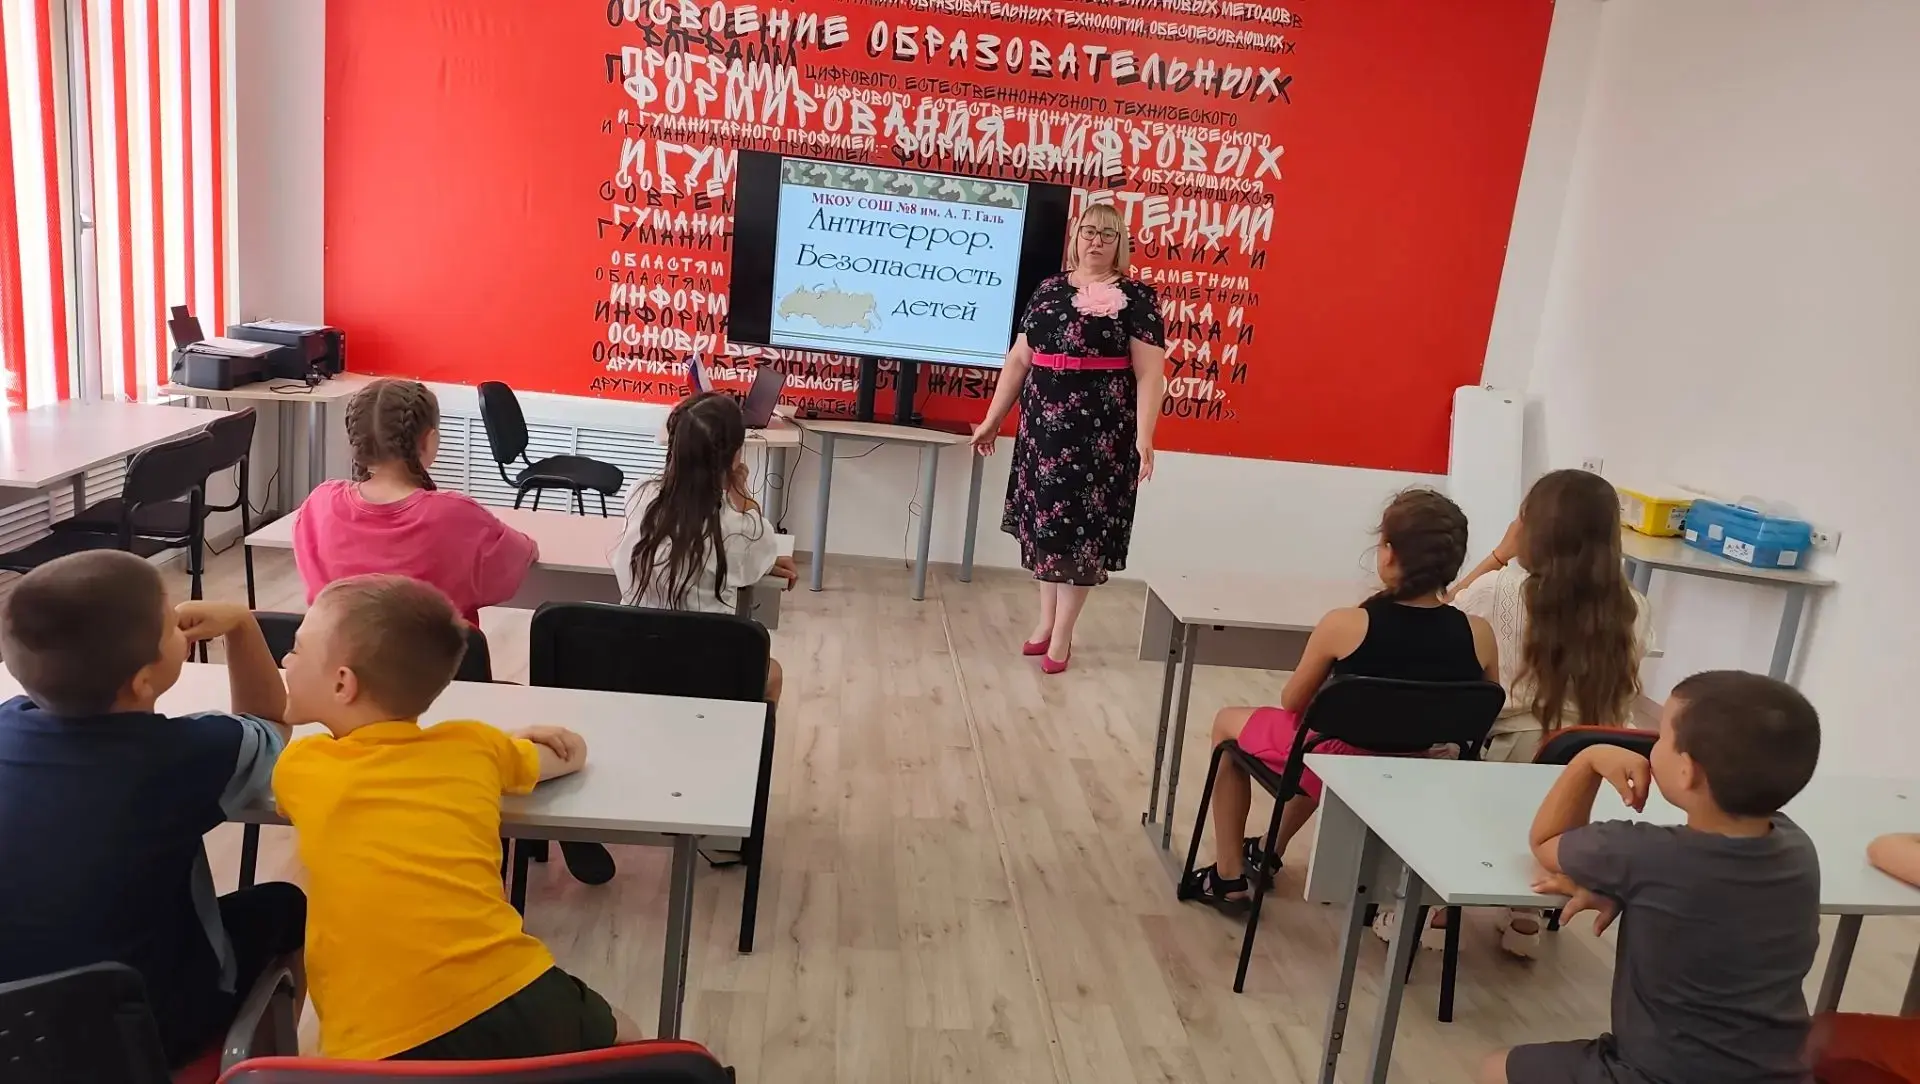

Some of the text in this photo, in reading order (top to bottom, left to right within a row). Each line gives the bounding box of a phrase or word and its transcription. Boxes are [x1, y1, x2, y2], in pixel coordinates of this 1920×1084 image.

[1221, 1, 1290, 23] МЕТОДОВ
[623, 0, 1281, 96] ОСВОЕНИЕ ОБРАЗОВАТЕЛЬНЫХ
[1150, 22, 1285, 48] ОБЕСПЕЧИВАЮЩИХ
[621, 46, 799, 92] ПРОГРАММ
[624, 75, 1284, 180] ФОРМИРОВАНИЯ ЦИФРОВЫХ
[1114, 99, 1237, 127] ТЕХНИЧЕСКОГО
[618, 109, 629, 124] И
[639, 110, 780, 141] ГУМАНИТАРНОГО
[896, 126, 1123, 178] ФОРМИРОВАНИЕ
[1141, 120, 1271, 147] ТЕХНИЧЕСКОГО
[619, 137, 645, 178] И
[616, 168, 736, 198] СОВРЕ
[1128, 165, 1264, 194] У ОБУЧАЮЩИХСЯ
[613, 203, 735, 237] ГУМАНИ
[811, 192, 1005, 225] МКОУ СОШ №8 им. А. Т. Галь
[808, 207, 994, 255] Антитеррор.
[611, 250, 724, 277] ОБЛАСТЯМ
[795, 243, 1003, 287] Безопасность
[891, 297, 980, 322] детей
[608, 321, 718, 353] ОСНОВЫ
[606, 356, 668, 376] ДРУГИХ
